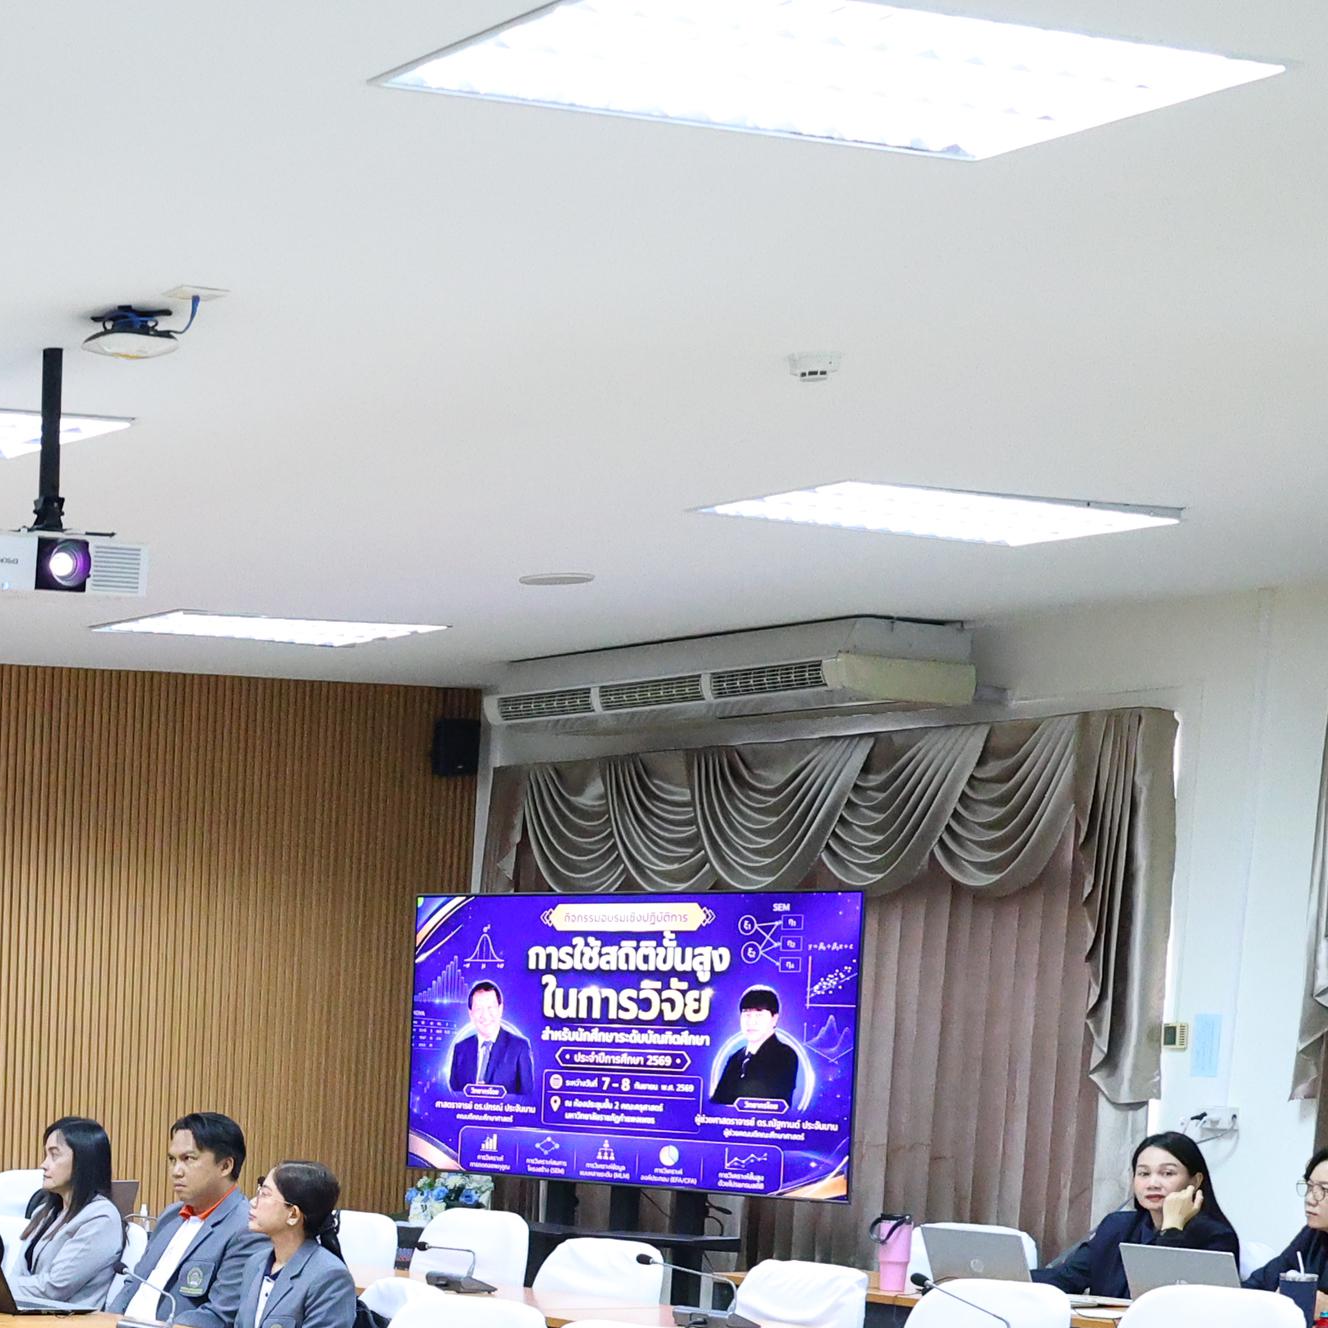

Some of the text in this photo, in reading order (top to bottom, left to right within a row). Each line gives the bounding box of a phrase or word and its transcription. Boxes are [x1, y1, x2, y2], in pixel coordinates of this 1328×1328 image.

[773, 903, 791, 912] SEM
[528, 930, 731, 983] การใช้สถิติขั้นสูง
[542, 974, 714, 1023] ในการวิจัย
[541, 1025, 711, 1046] สำหรับนักศึกษาระดับบัณฑิตศึกษา
[646, 1055, 672, 1067] 2569
